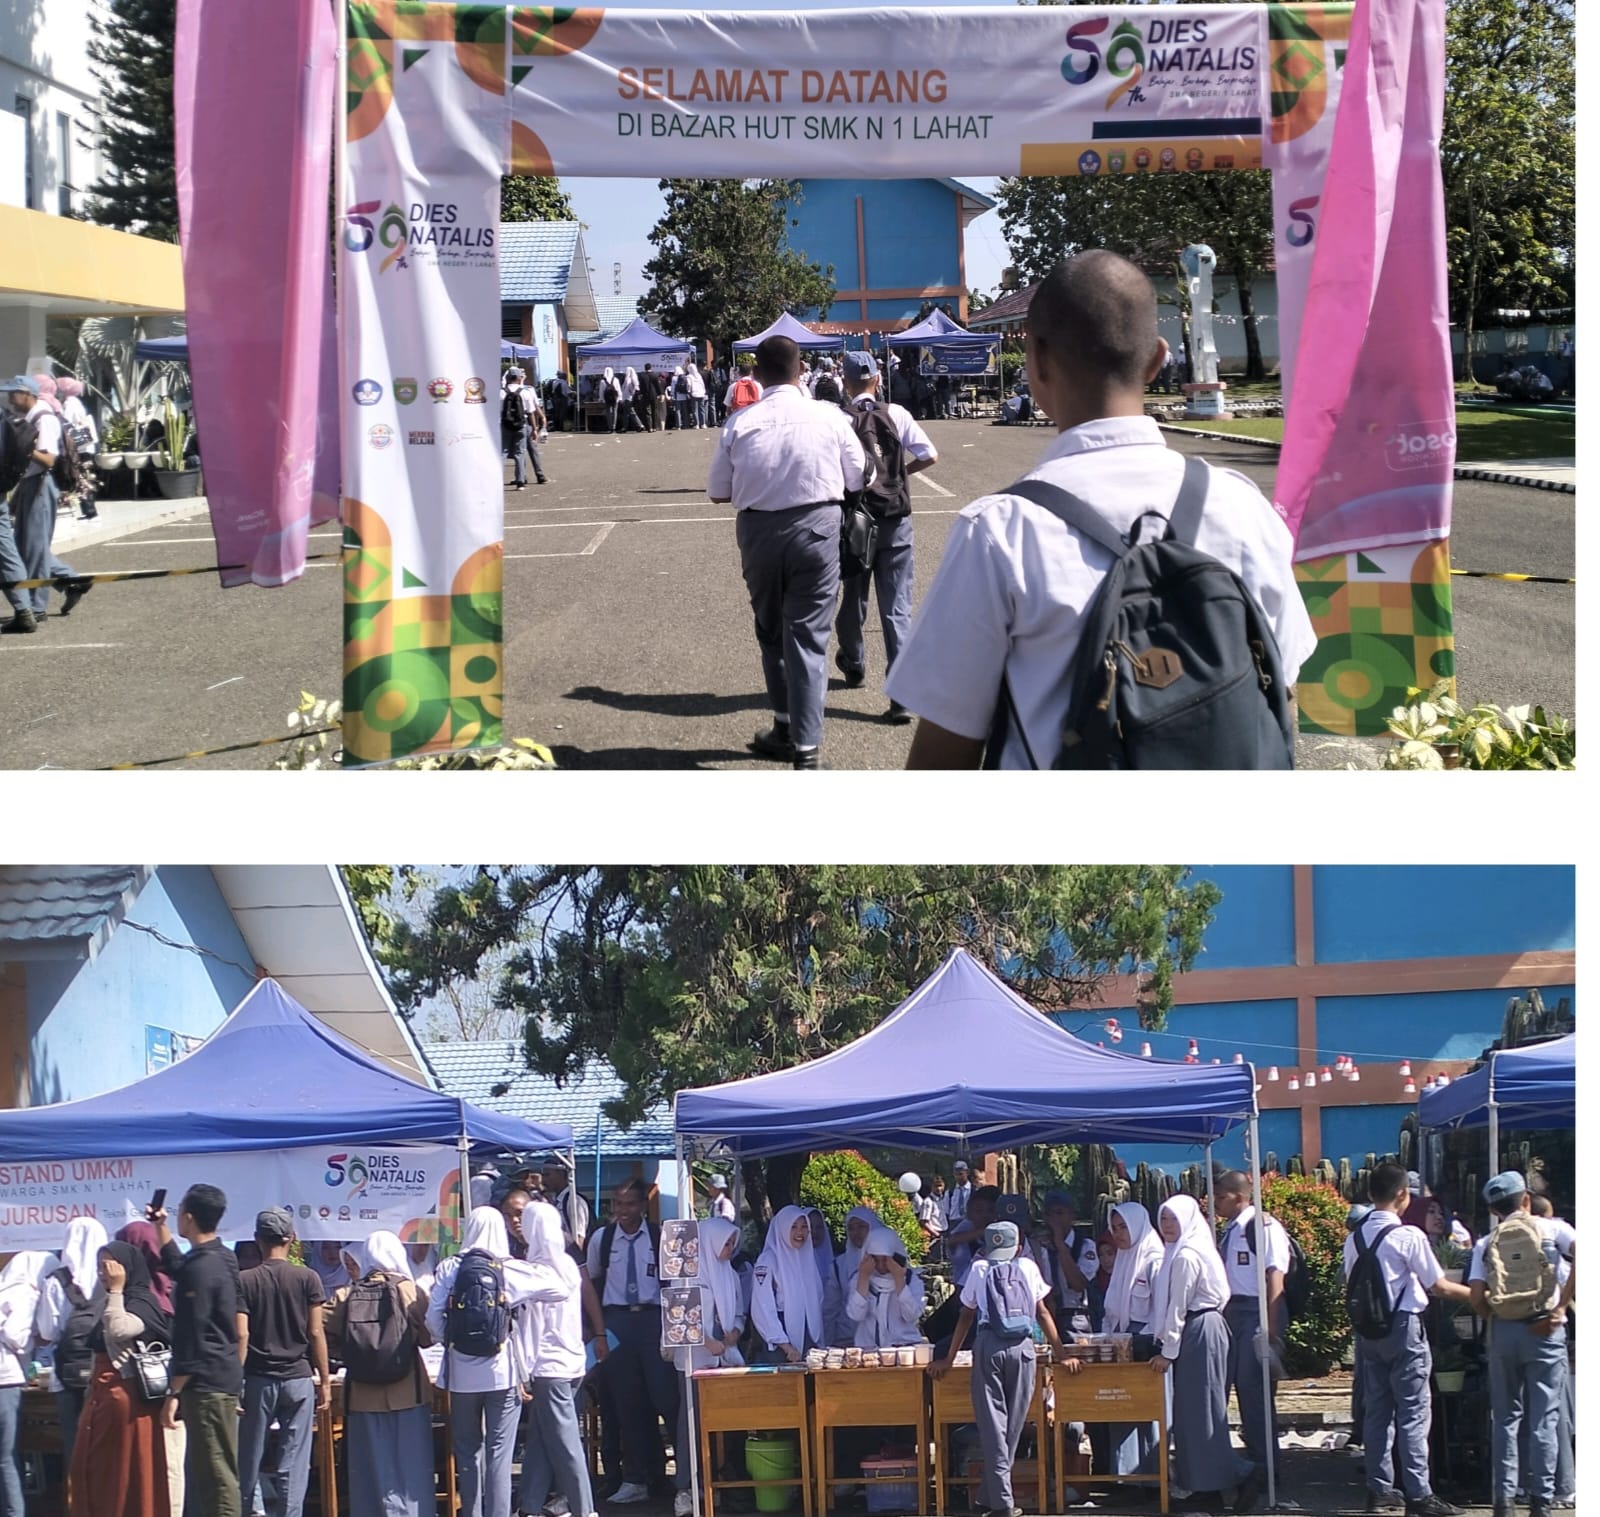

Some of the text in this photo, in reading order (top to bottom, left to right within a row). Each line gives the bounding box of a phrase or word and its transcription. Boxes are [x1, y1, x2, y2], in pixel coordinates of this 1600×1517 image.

[1148, 19, 1208, 44] DIES
[1060, 17, 1145, 113] 59
[1148, 47, 1257, 72] NATALIS
[617, 67, 948, 104] SELAMAT DATANG
[618, 112, 993, 140] DI BAZAR HUT SMK N 1 LAHAT
[409, 203, 457, 223] DIES
[409, 225, 494, 248] NATALIS
[0, 1159, 134, 1185] STAND UMKM
[368, 1155, 400, 1168] DIES
[369, 1170, 426, 1183] NATALIS
[0, 1186, 46, 1198] WARGA
[52, 1184, 79, 1194] SMK
[84, 1184, 92, 1193] N
[111, 1180, 153, 1192] LAHAT
[1, 1203, 97, 1227] JURUSAN
